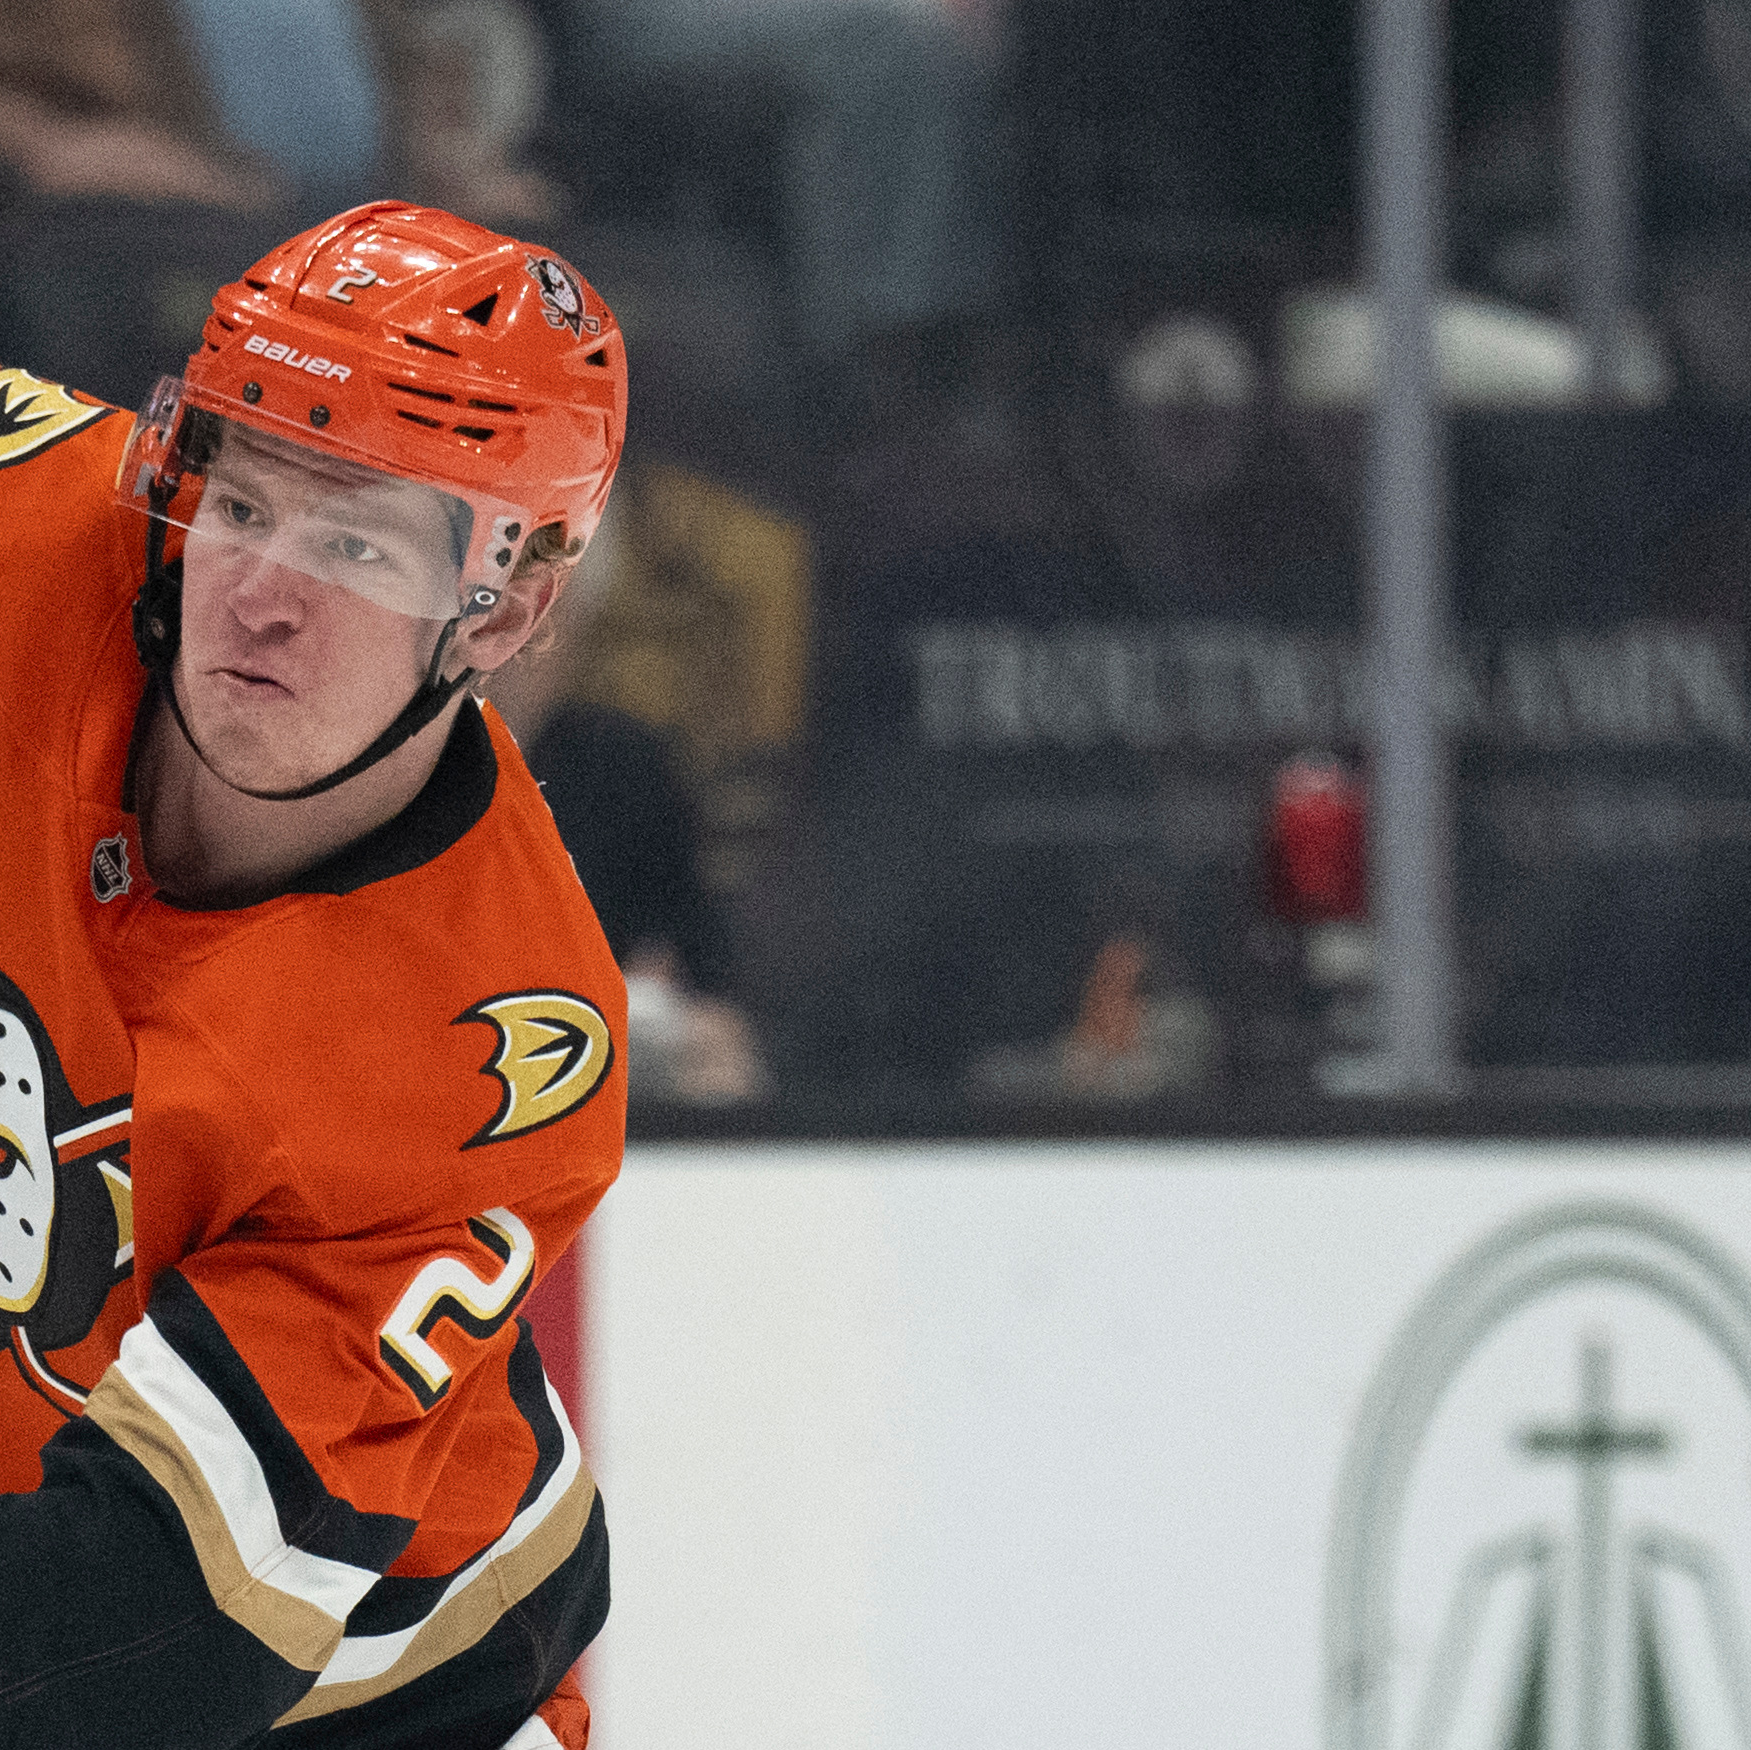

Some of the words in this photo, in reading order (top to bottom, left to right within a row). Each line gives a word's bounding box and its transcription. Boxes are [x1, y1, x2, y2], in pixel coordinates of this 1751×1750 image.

[327, 268, 377, 303] 2
[96, 853, 119, 885] NHL
[379, 1206, 536, 1412] 2
